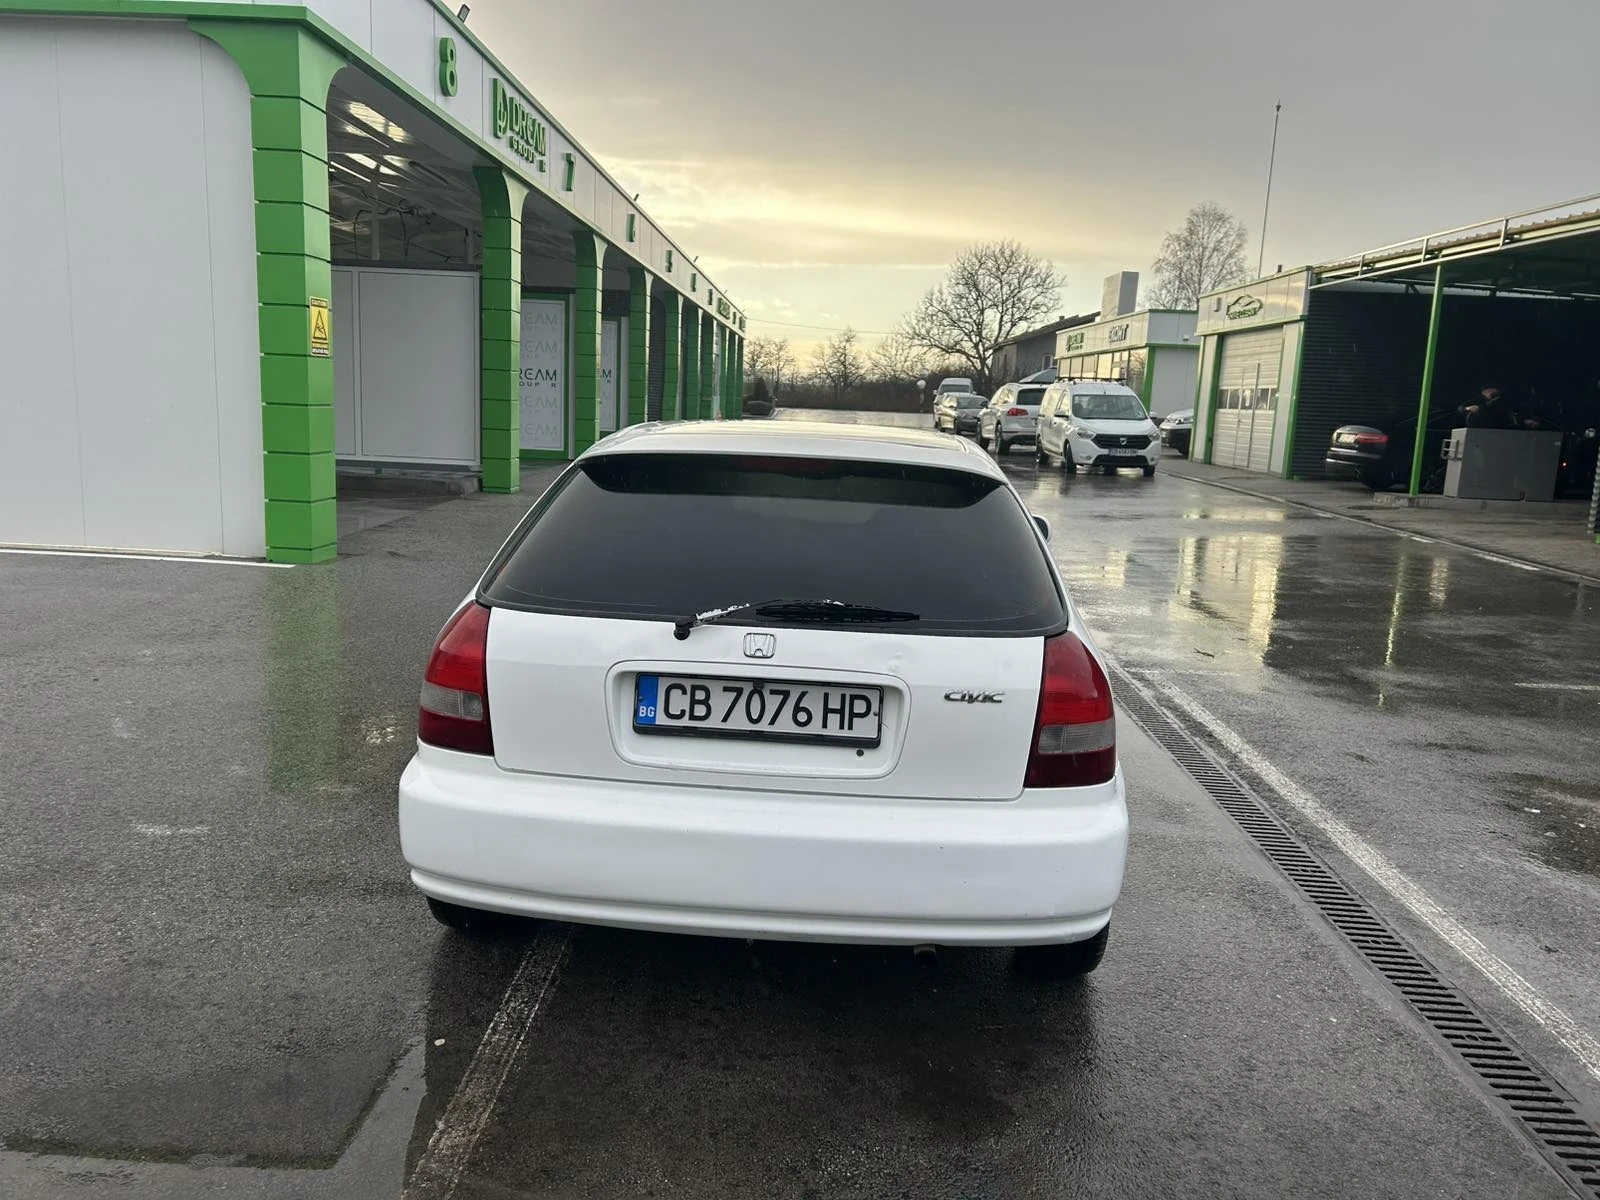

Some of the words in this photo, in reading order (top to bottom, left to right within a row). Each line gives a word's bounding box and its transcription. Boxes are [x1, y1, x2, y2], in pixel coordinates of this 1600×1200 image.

[438, 37, 458, 97] 8
[508, 97, 546, 157] DREAM
[564, 152, 576, 192] 7
[639, 706, 656, 718] BG
[663, 682, 712, 721] CB
[720, 685, 814, 728] 7076
[821, 691, 873, 731] HP
[944, 690, 1005, 704] CIVIC
